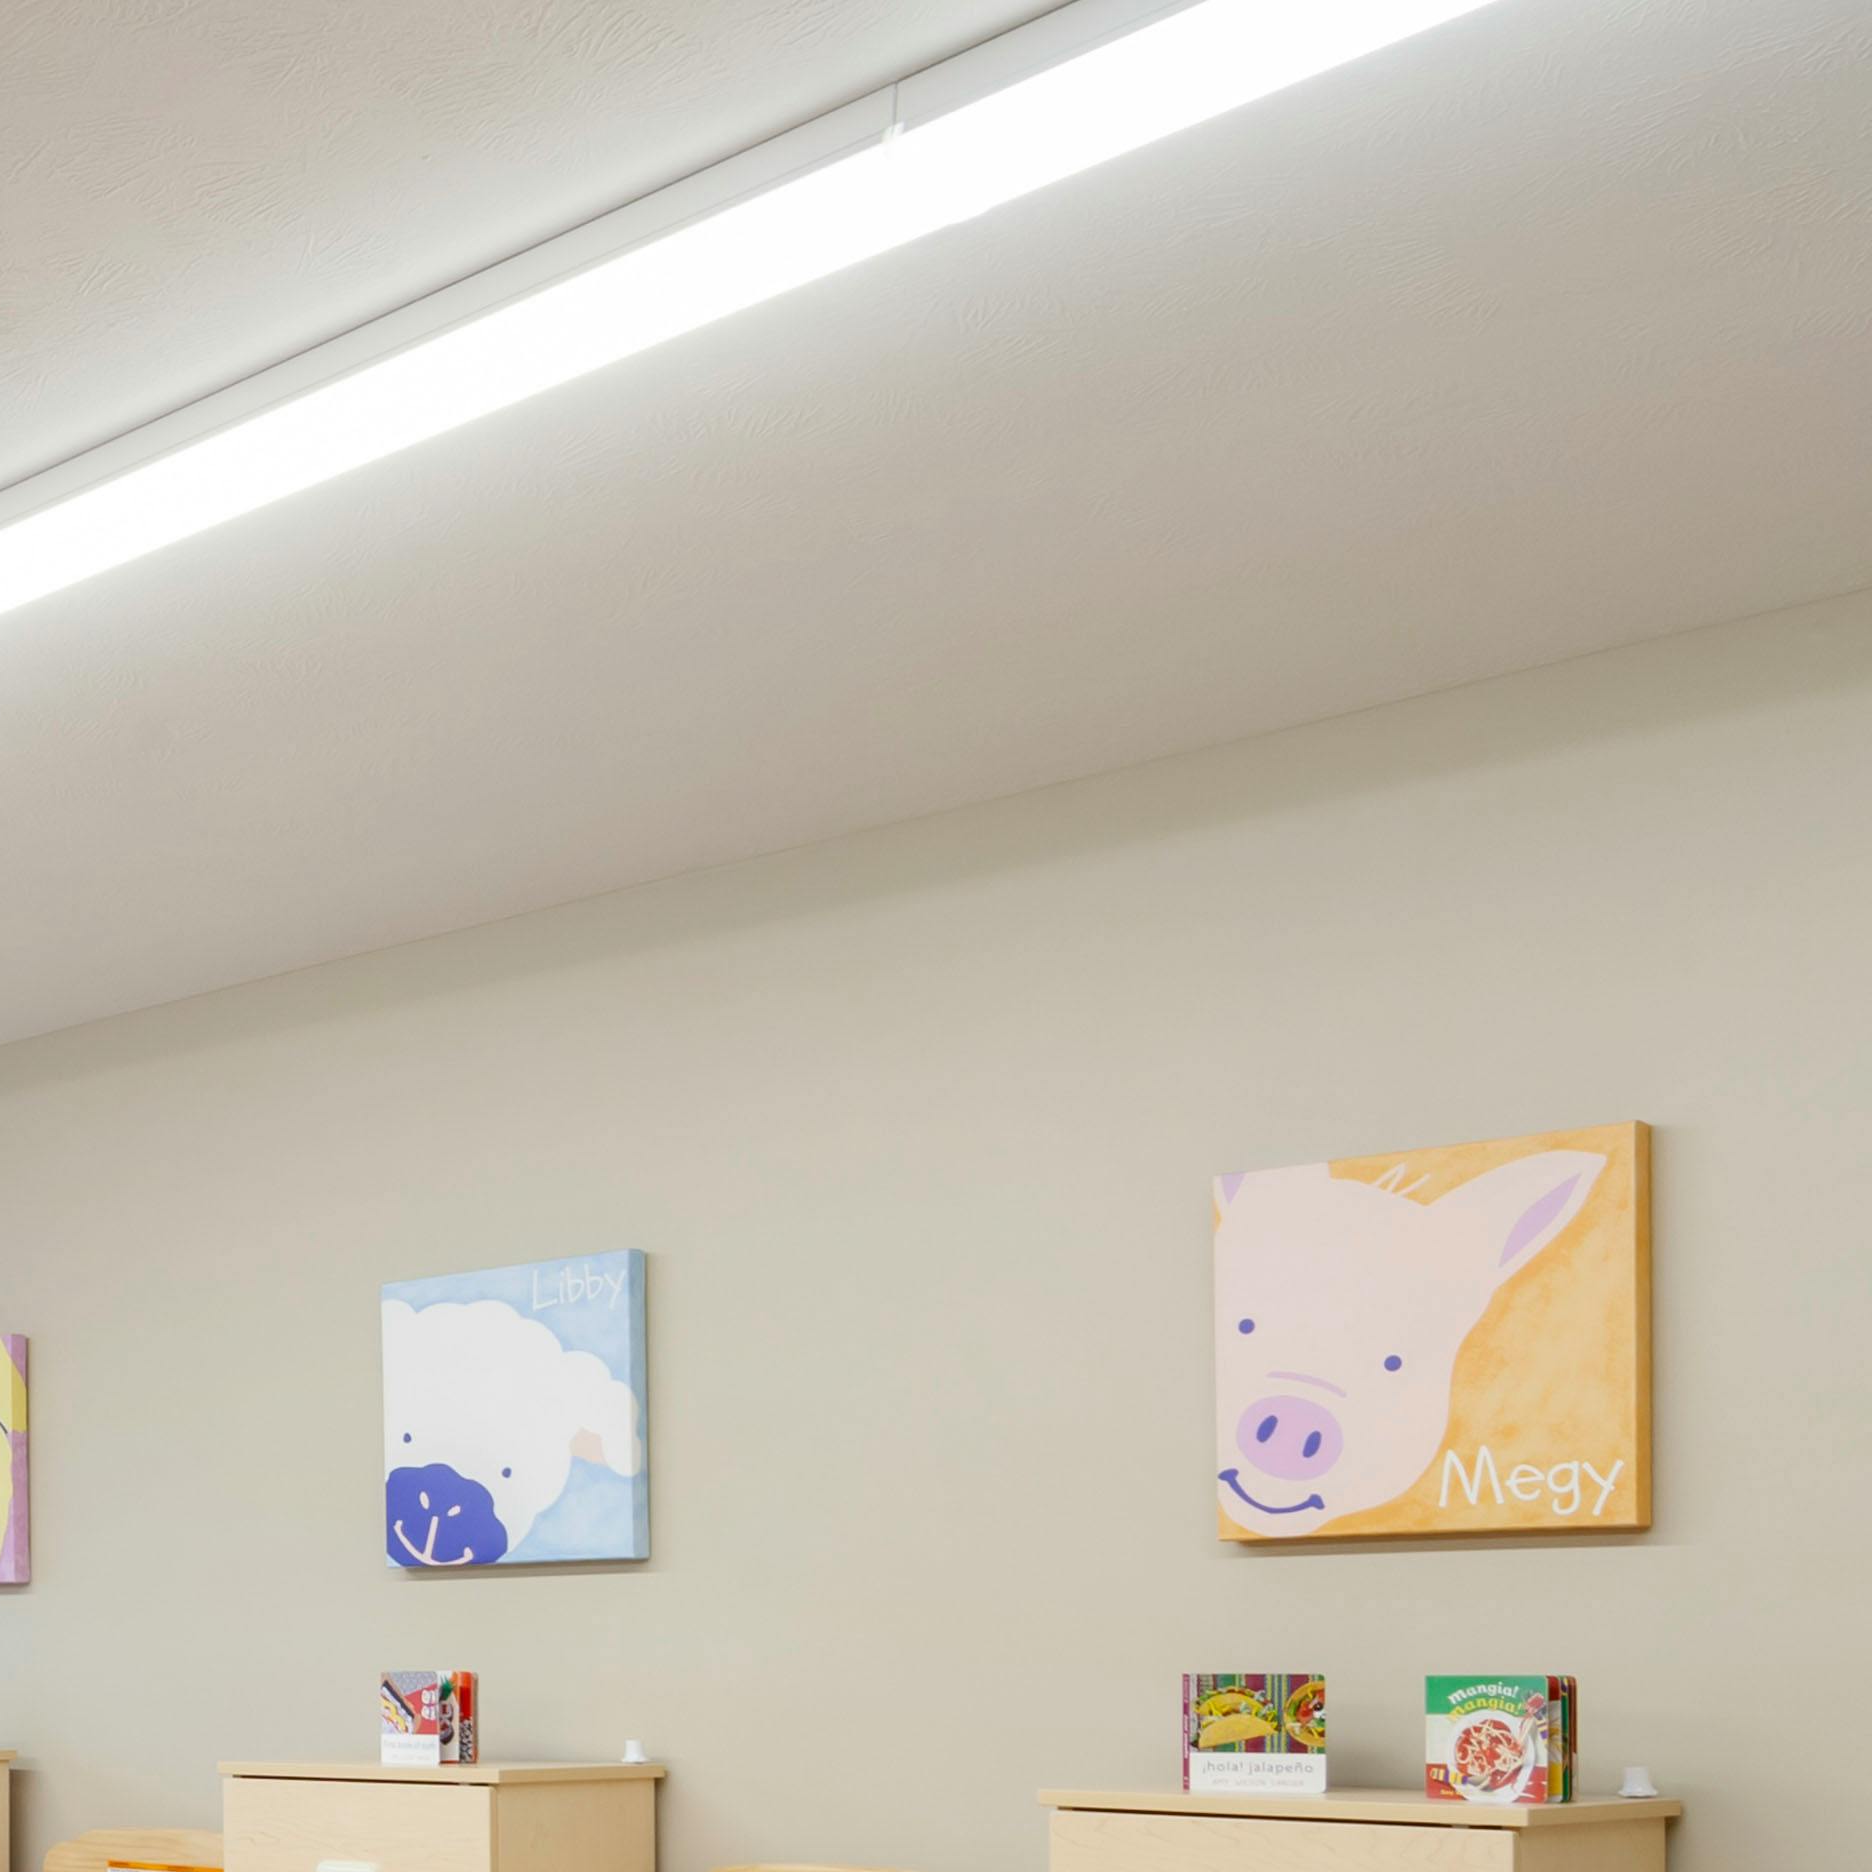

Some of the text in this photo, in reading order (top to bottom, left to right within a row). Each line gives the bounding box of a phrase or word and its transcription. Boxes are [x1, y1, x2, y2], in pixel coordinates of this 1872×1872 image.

[531, 1263, 628, 1312] Libby
[1437, 1444, 1624, 1517] Megy
[1448, 1681, 1520, 1705] mangia!
[1448, 1695, 1523, 1721] mangia!
[1248, 1760, 1314, 1775] jalapeño
